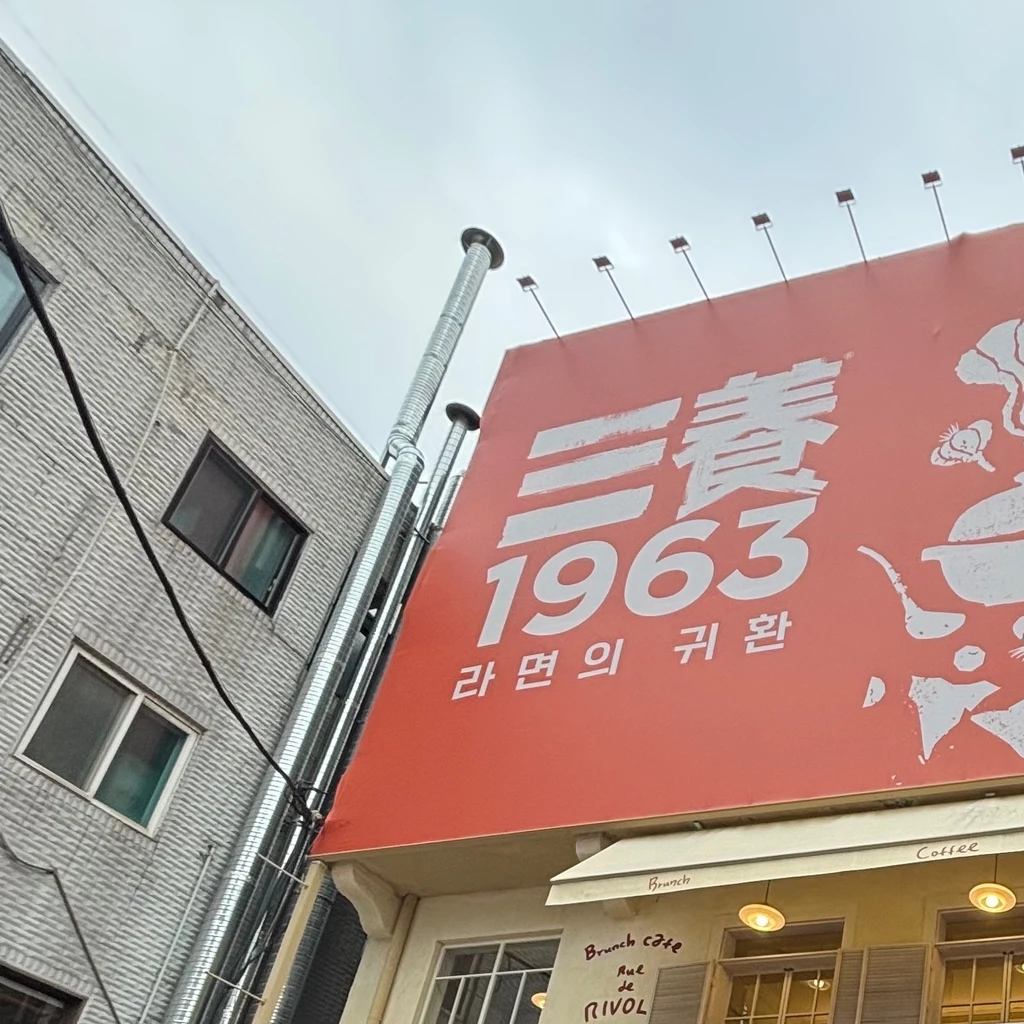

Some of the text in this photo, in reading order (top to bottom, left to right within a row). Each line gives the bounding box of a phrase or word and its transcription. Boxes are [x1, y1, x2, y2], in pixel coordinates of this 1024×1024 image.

[496, 357, 843, 549] 三養
[476, 496, 818, 648] 1963
[450, 610, 792, 701] 라면의 귀환
[916, 842, 979, 860] Coffee
[648, 874, 691, 892] Brunch
[584, 932, 636, 961] Brunch
[617, 980, 635, 993] de
[584, 997, 647, 1023] RIVOL
